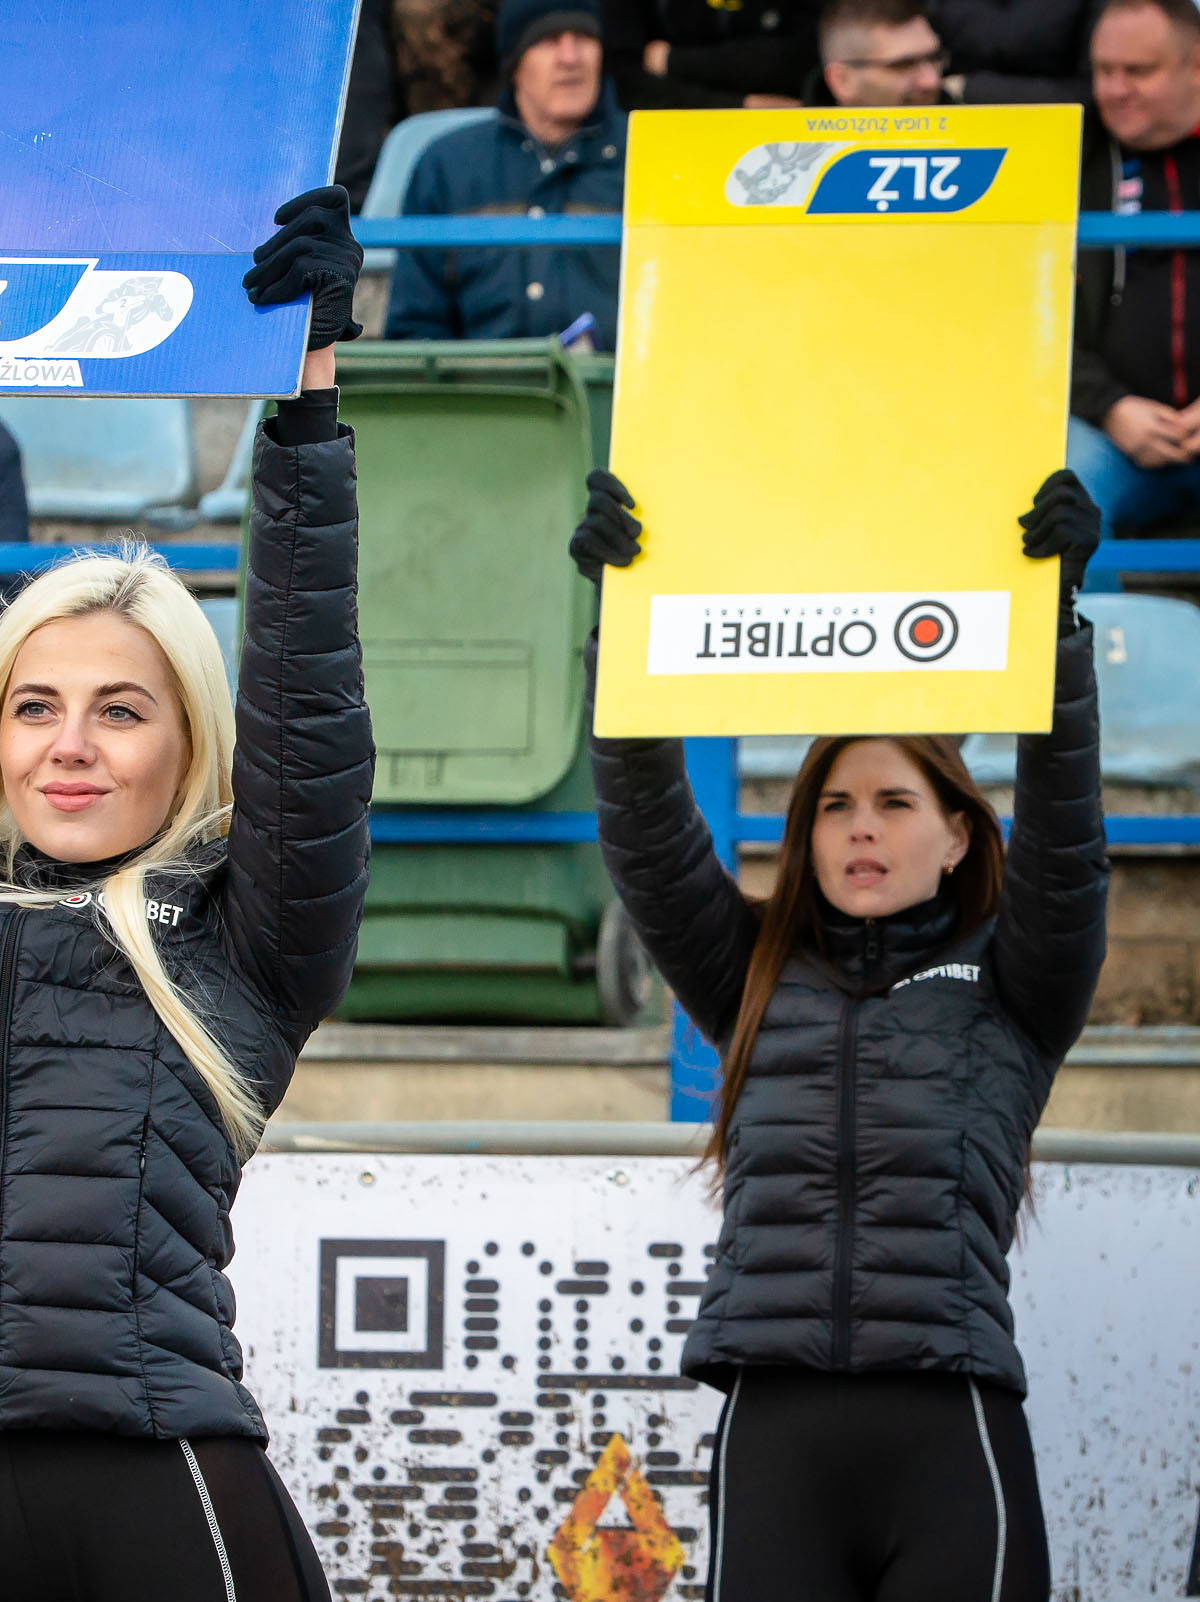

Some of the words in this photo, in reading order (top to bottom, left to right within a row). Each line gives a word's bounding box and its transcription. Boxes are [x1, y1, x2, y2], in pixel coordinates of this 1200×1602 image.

[893, 116, 930, 131] LIGA
[866, 156, 962, 212] 2LŻ
[696, 620, 877, 658] OPTIBET
[912, 963, 981, 982] OPTIBET
